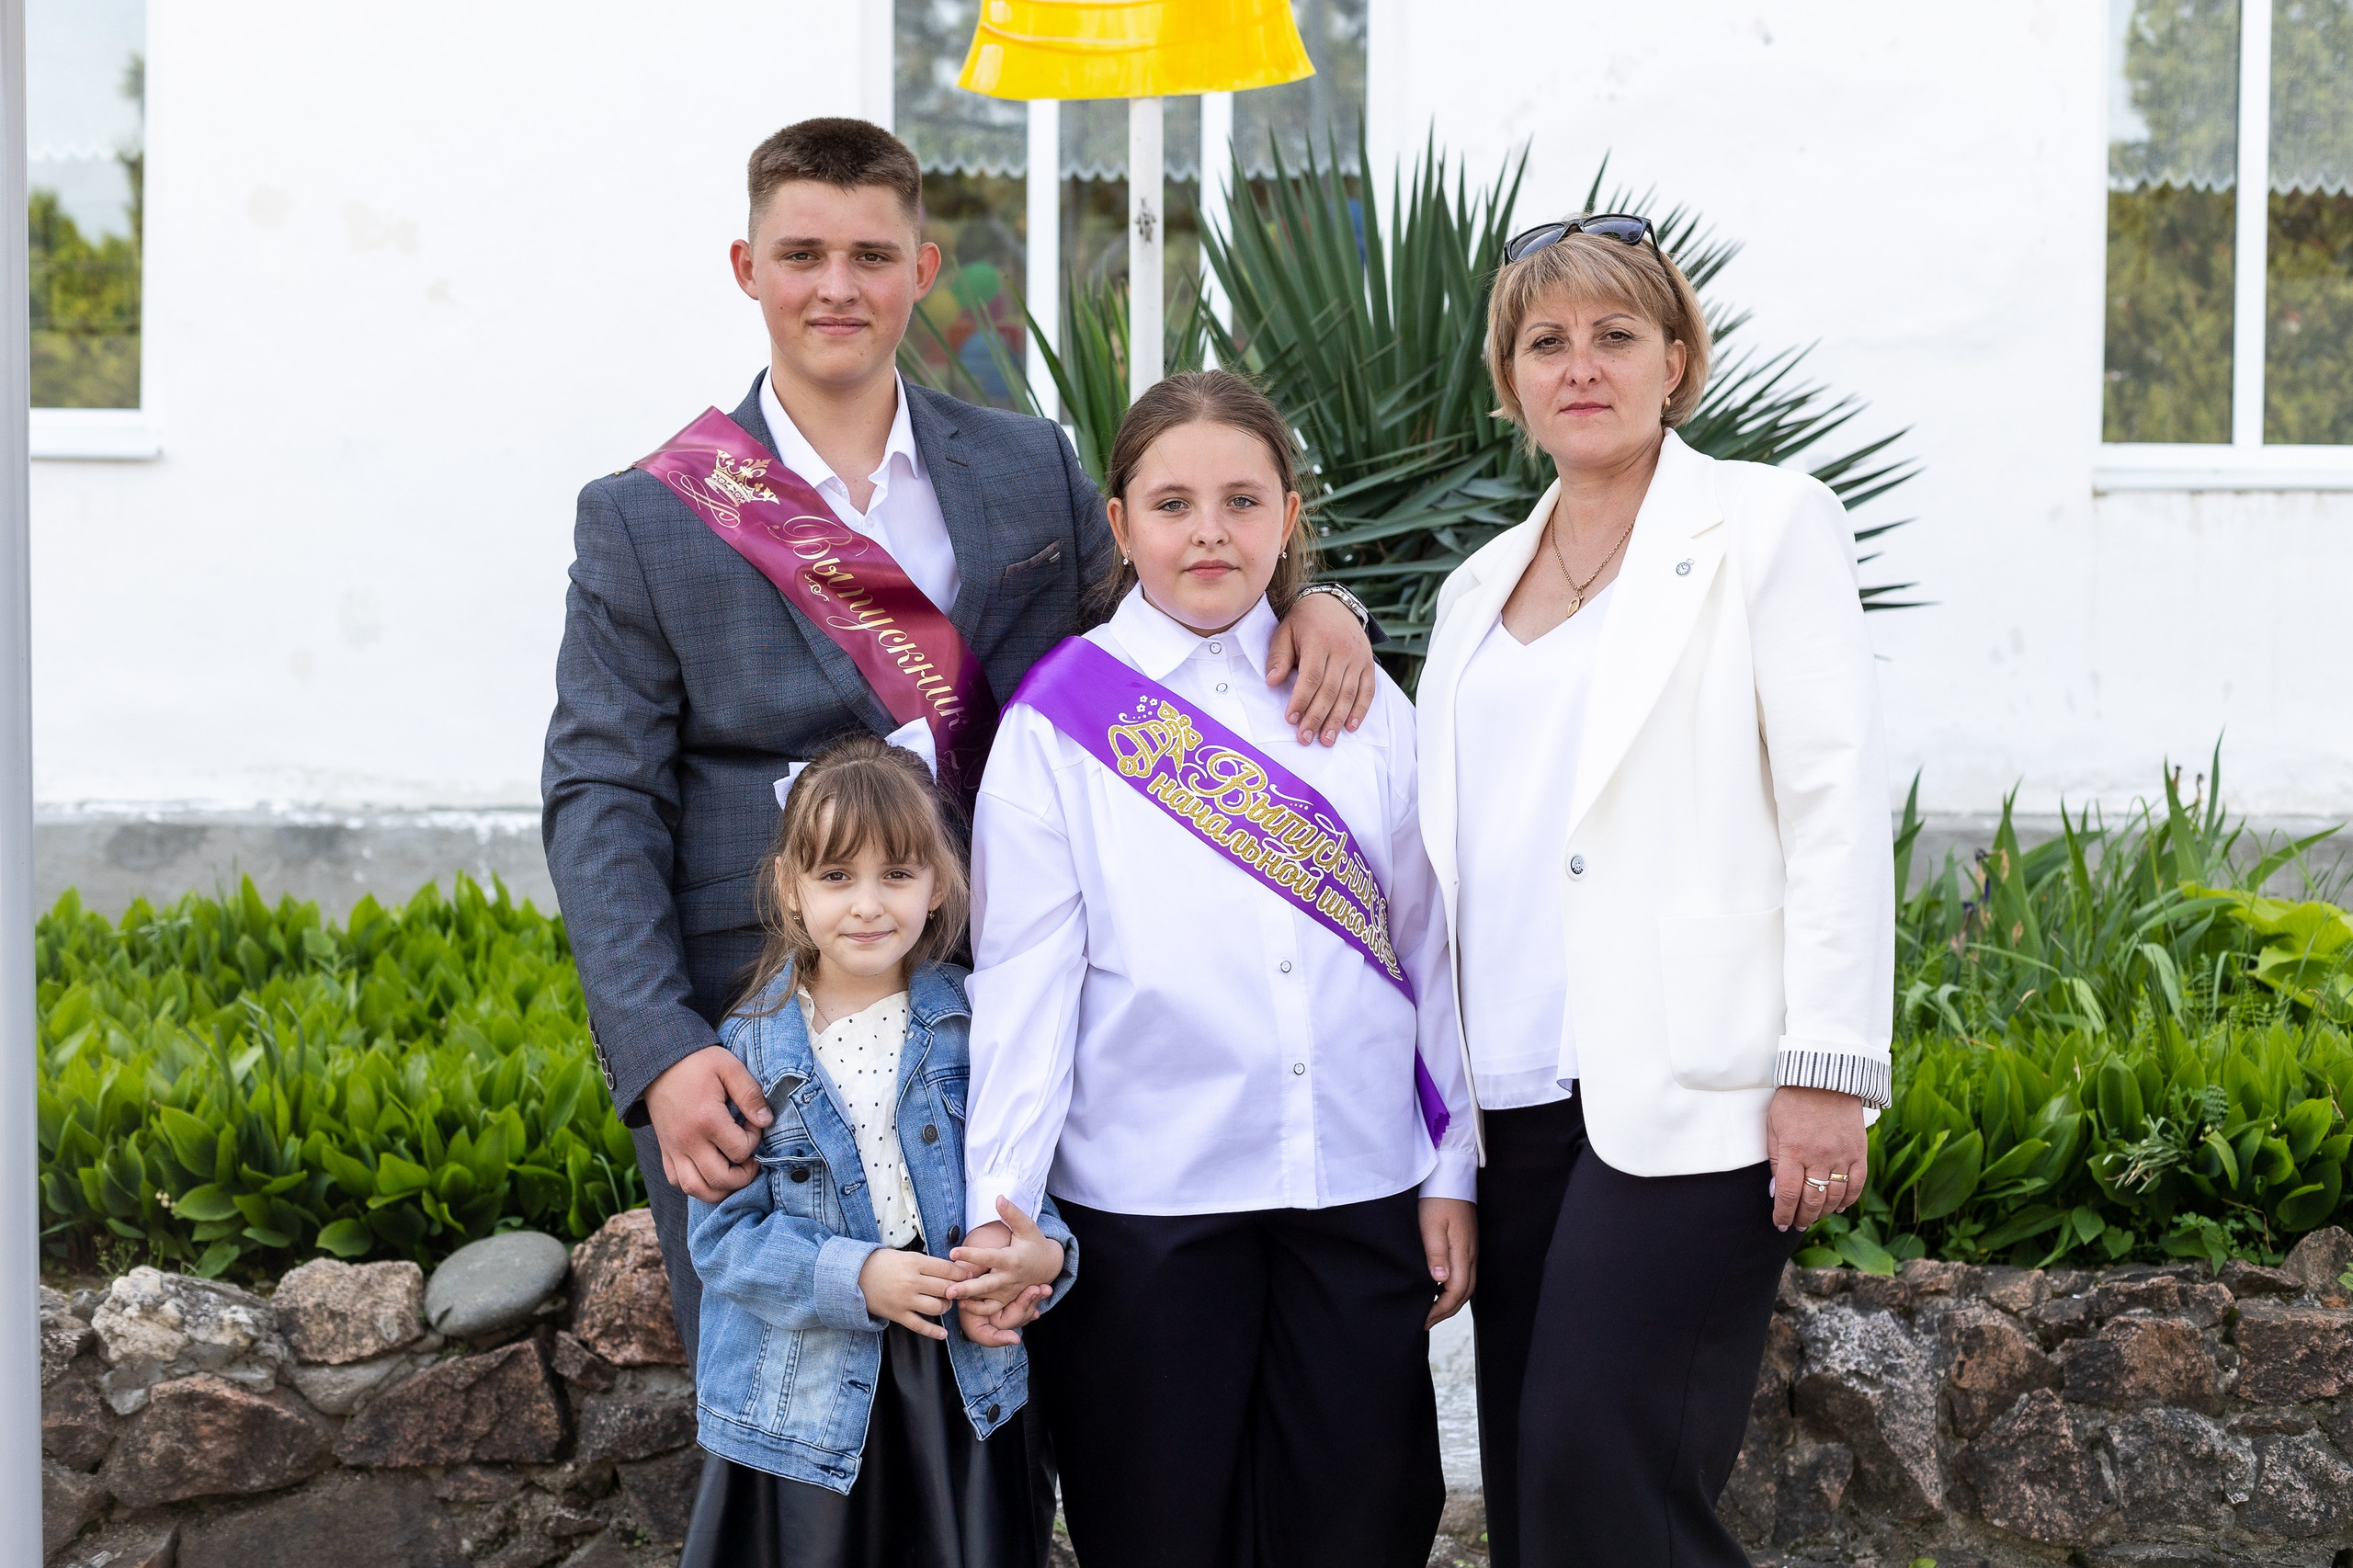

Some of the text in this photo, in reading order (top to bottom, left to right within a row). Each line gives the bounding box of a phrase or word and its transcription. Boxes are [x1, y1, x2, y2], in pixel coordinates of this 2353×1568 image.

[767, 515, 969, 732] Выпускник
[1147, 770, 1324, 903] начальной
[1184, 745, 1379, 915] Выпускник
